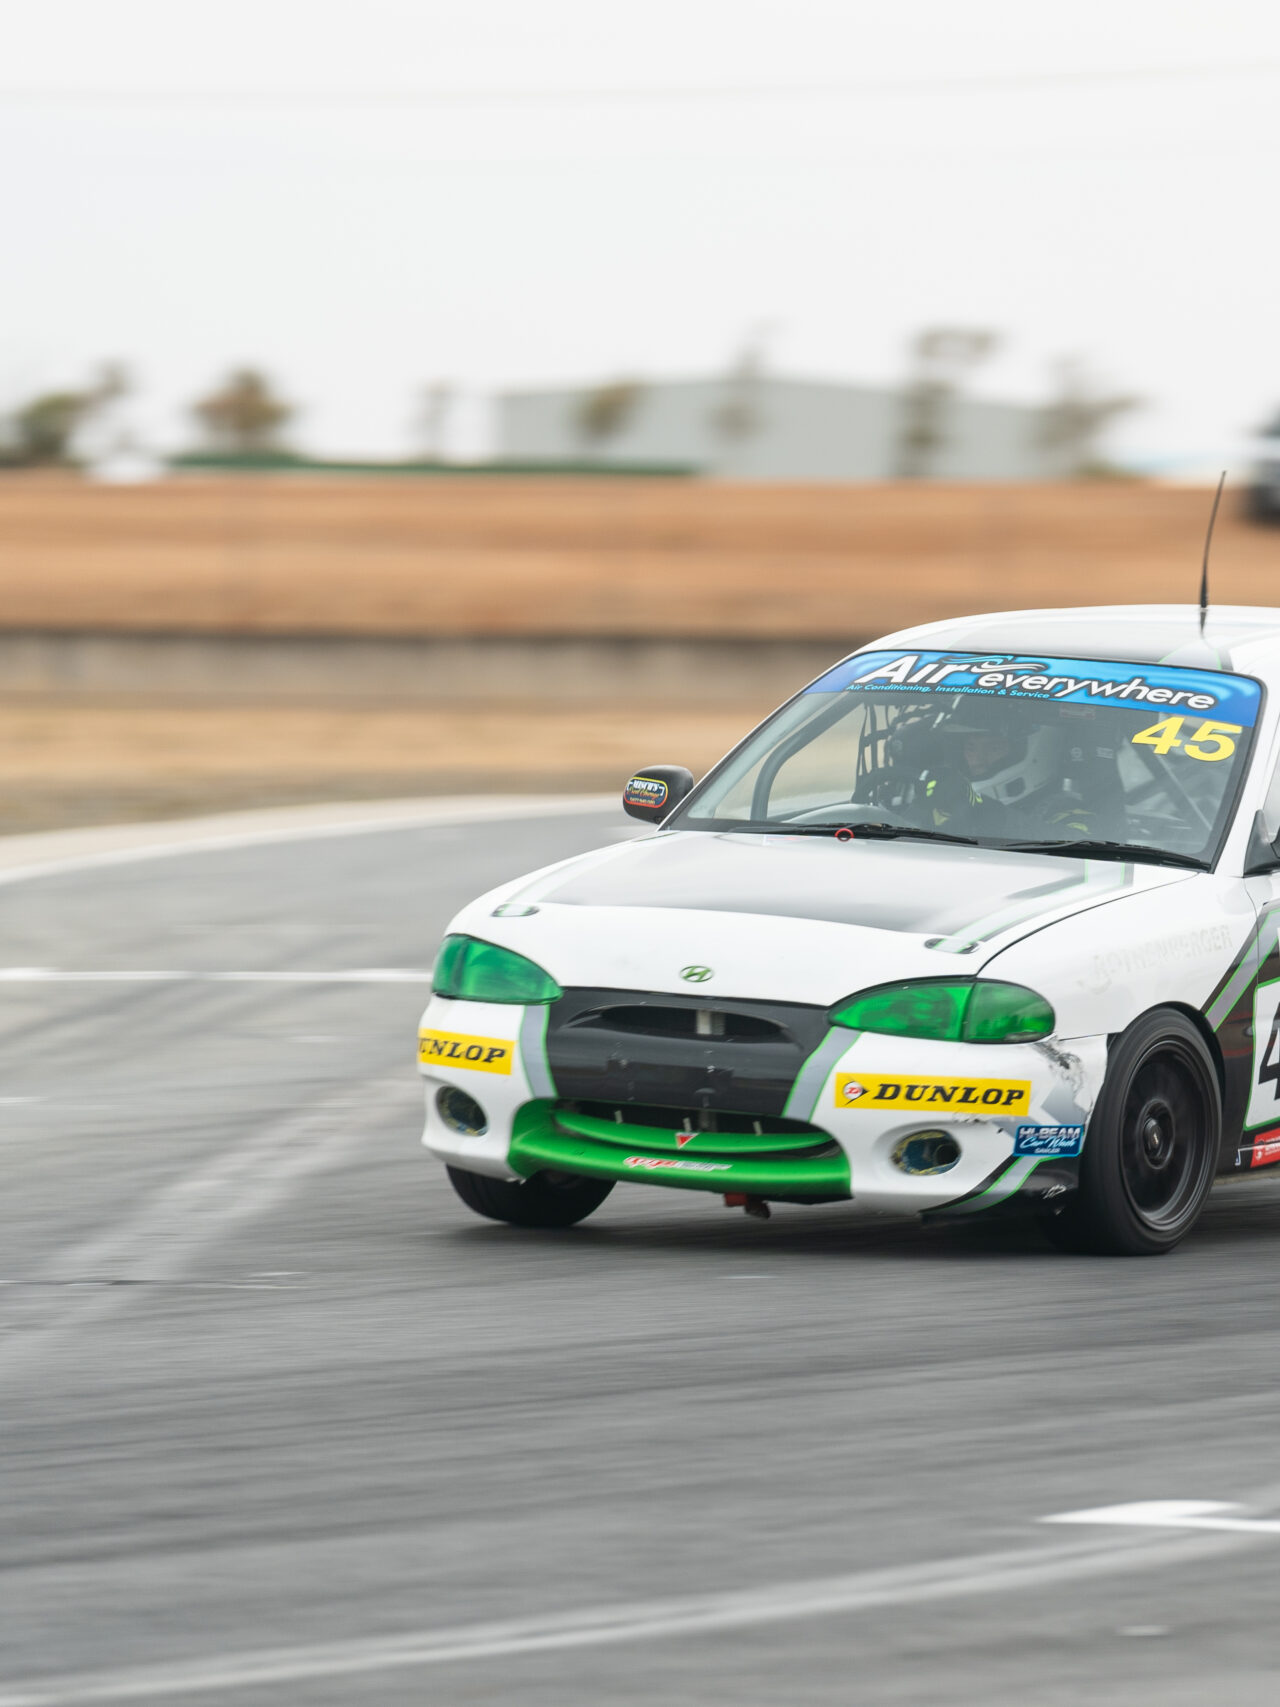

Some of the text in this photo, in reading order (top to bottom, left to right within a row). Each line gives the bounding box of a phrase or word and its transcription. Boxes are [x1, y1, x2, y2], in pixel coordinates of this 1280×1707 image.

[855, 655, 1215, 710] Air everywhere
[864, 684, 932, 693] Conditioning,
[935, 686, 995, 695] Installation
[1009, 689, 1050, 699] Service
[1131, 716, 1243, 762] 45
[418, 1037, 506, 1063] UNLOP
[873, 1083, 1024, 1106] DUNLOP
